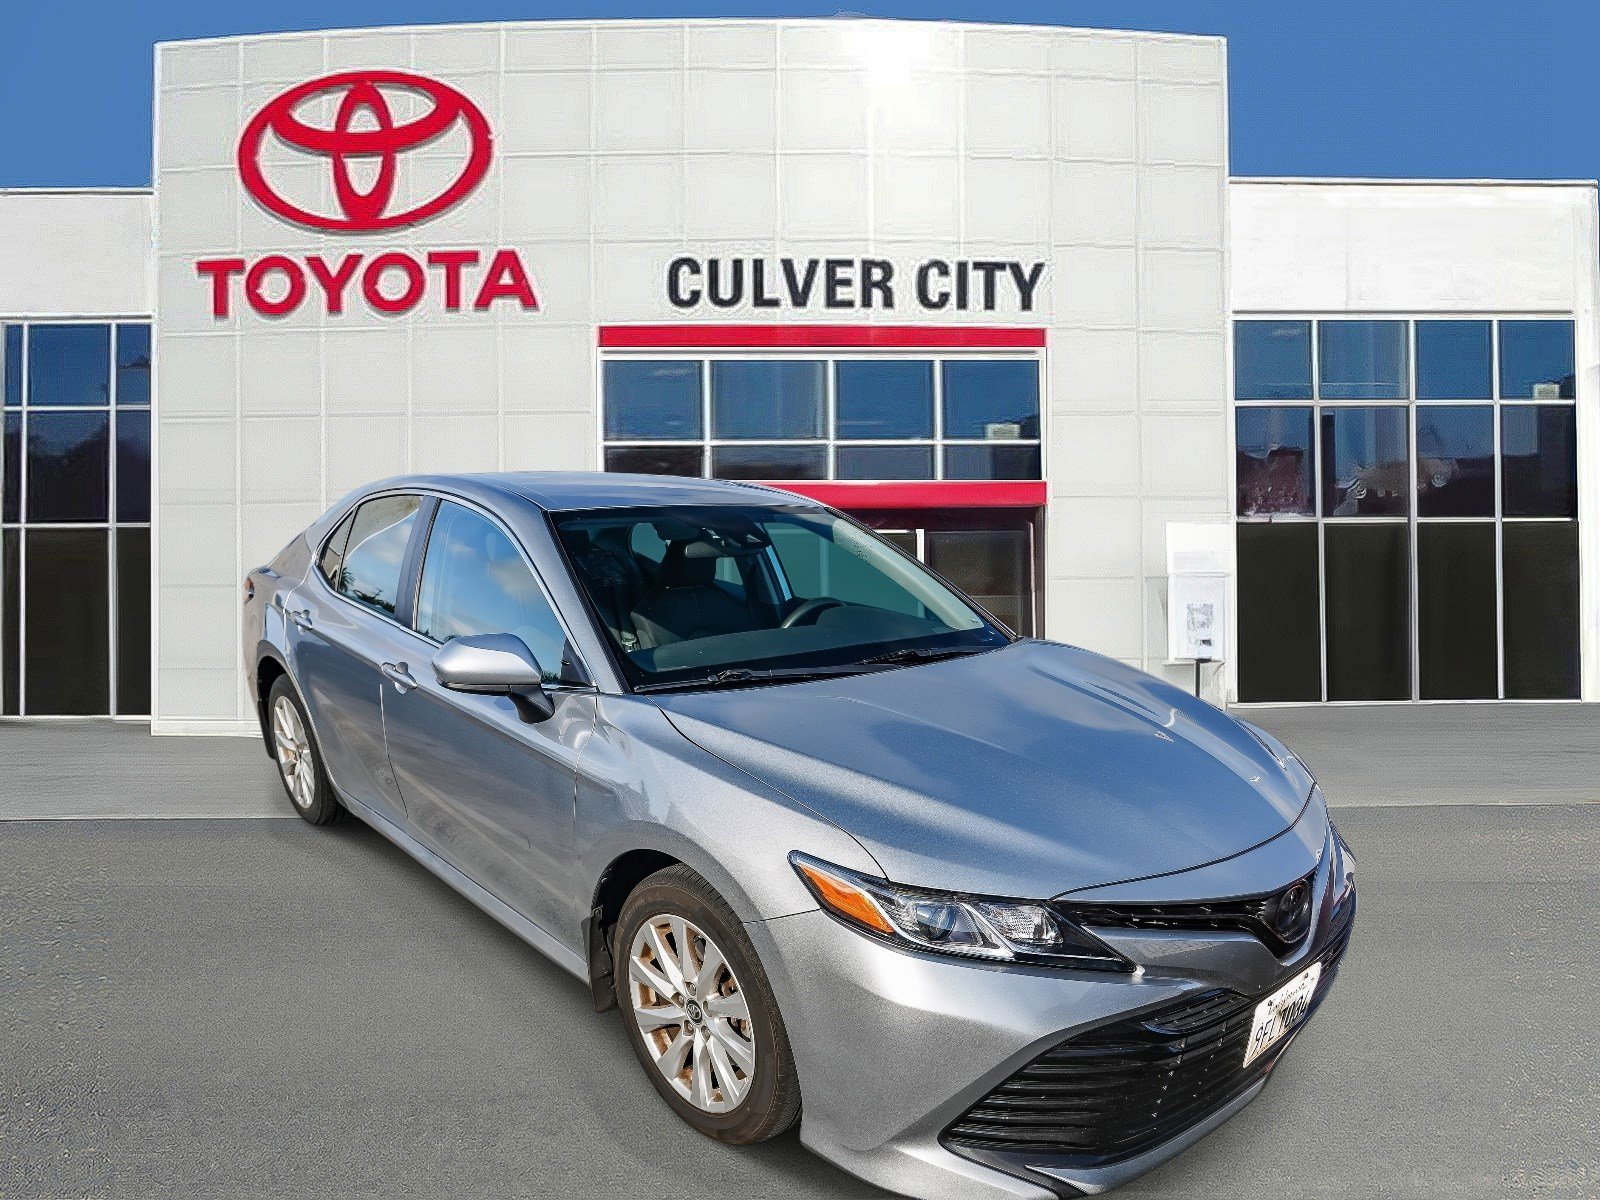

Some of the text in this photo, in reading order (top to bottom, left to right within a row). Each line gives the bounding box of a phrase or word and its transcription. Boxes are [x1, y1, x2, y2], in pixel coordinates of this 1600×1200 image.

[195, 249, 539, 319] TOYOTA
[668, 257, 1045, 311] CULVER CITY
